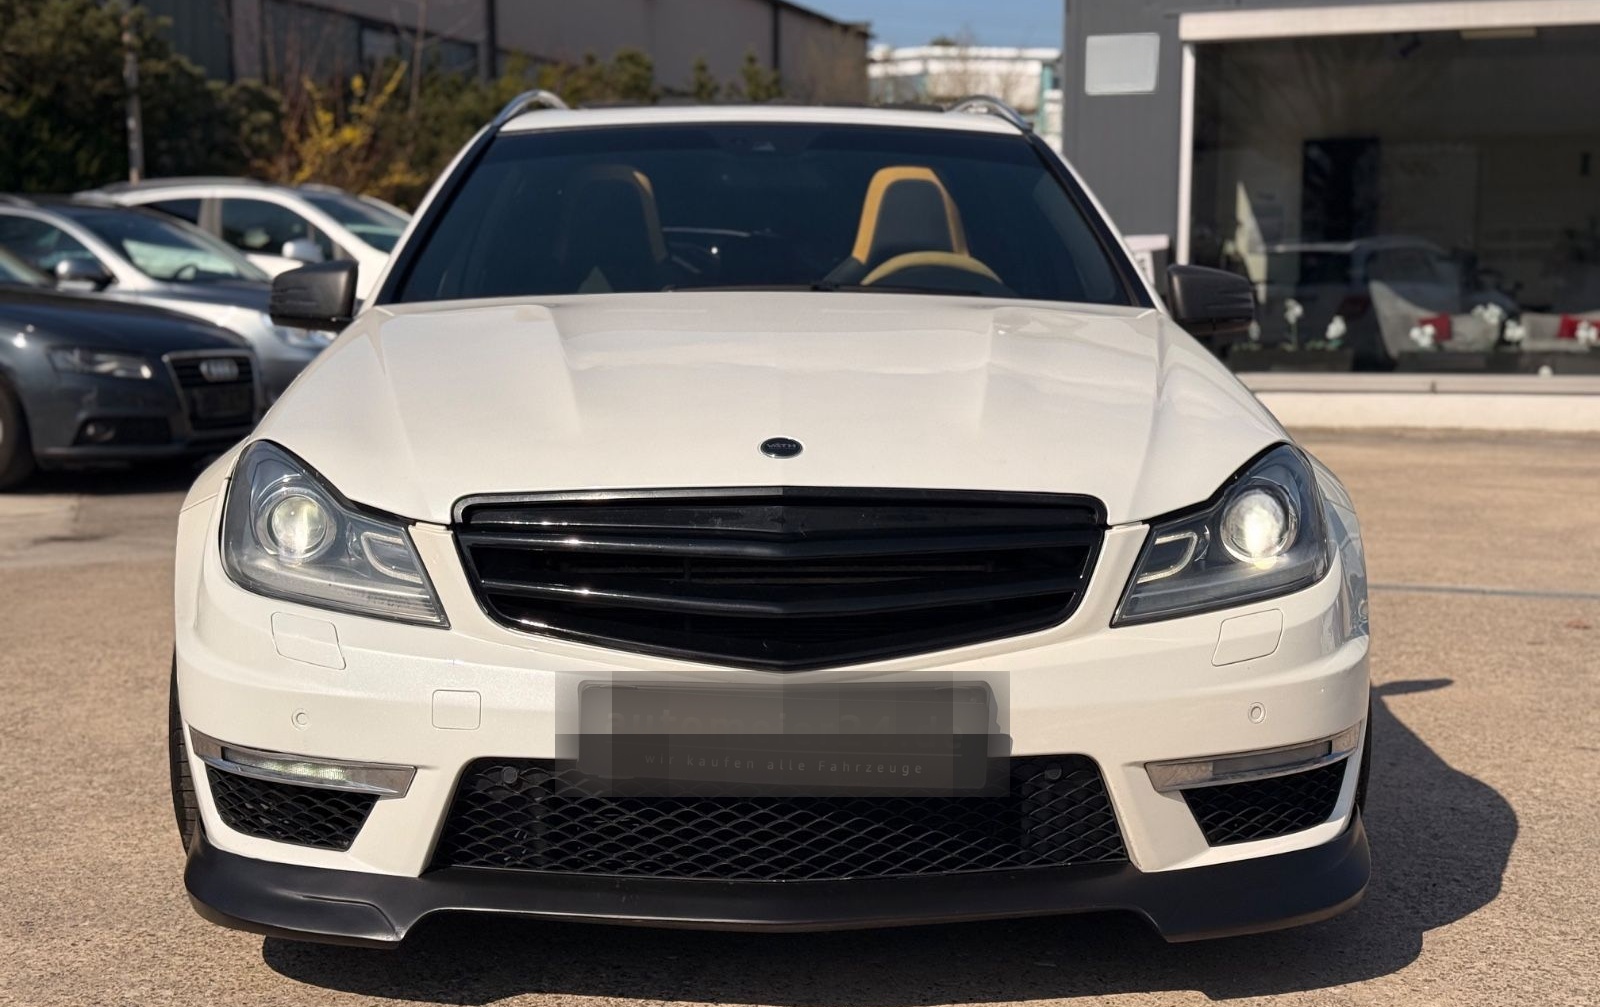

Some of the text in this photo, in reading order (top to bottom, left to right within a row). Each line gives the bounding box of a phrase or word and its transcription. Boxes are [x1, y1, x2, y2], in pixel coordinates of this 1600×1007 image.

[644, 753, 923, 775] wir kaufen alle Fahrzeuge
